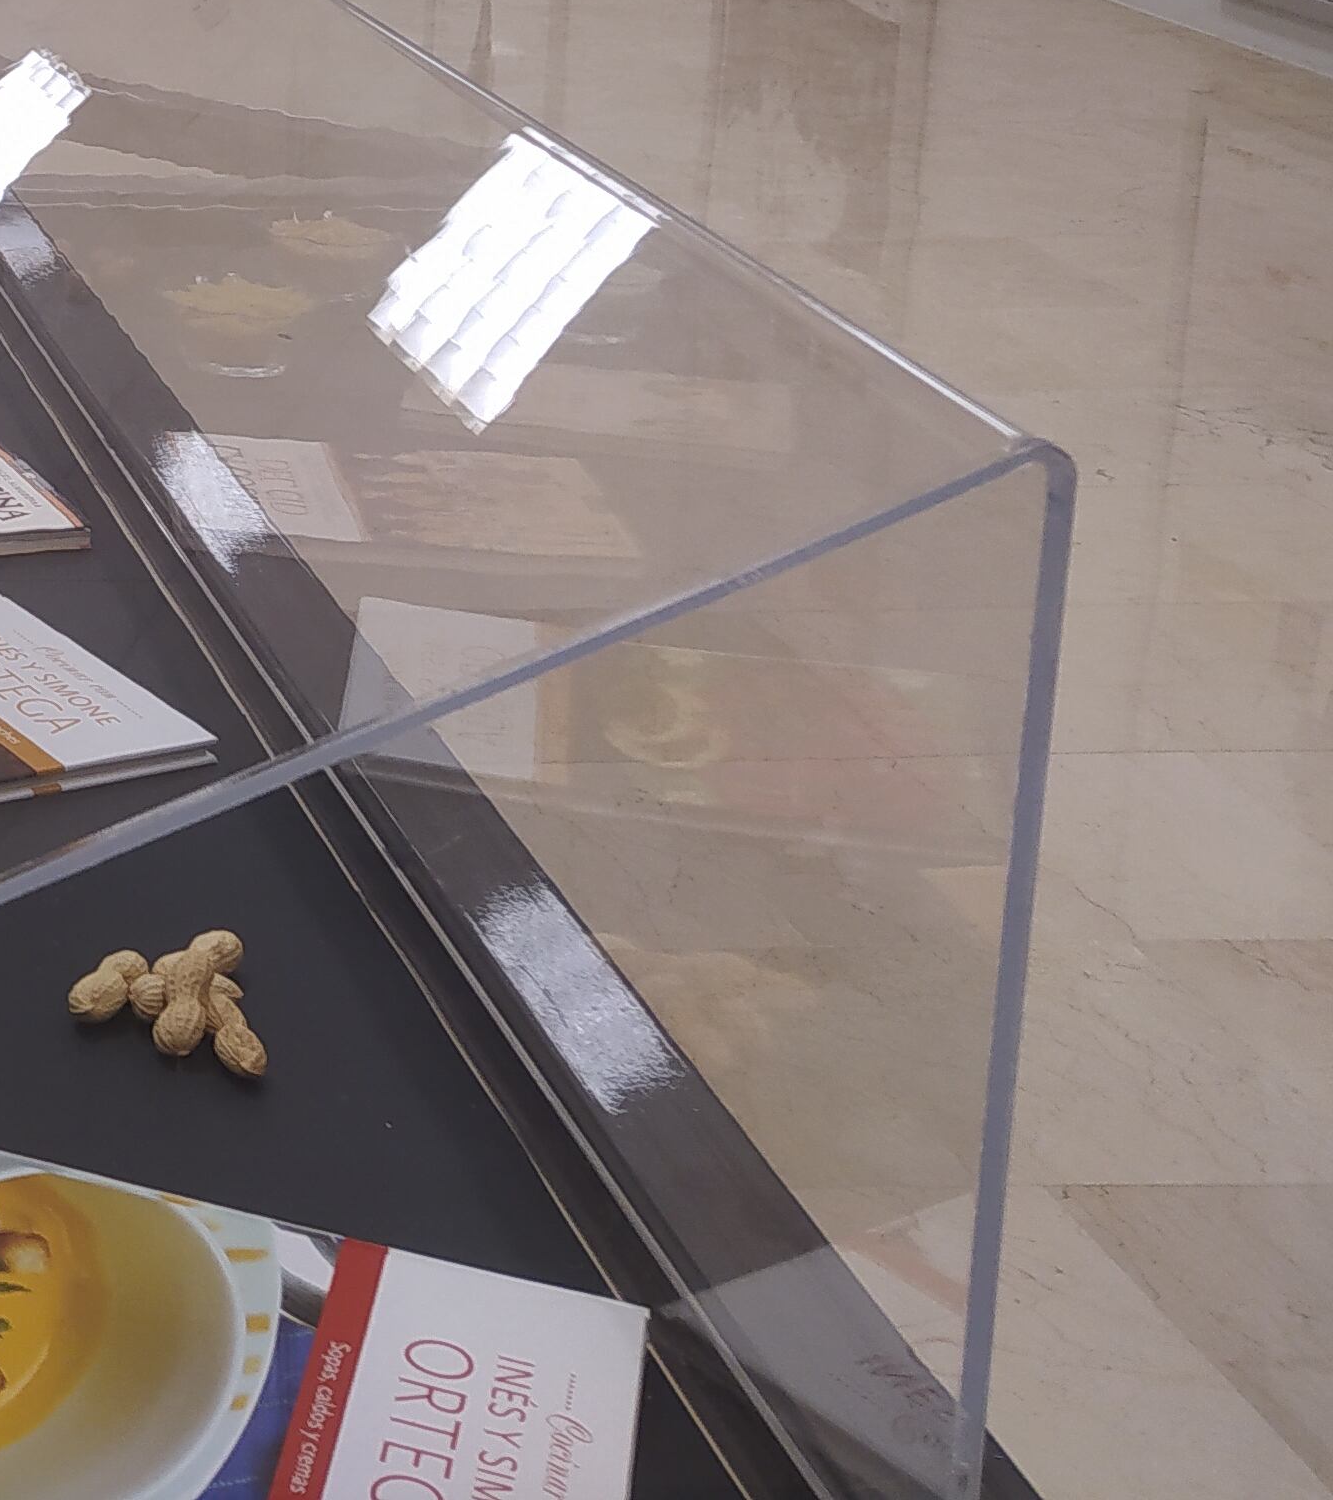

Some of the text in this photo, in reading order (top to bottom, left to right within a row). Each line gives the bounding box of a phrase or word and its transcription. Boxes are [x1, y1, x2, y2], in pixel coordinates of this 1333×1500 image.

[20, 661, 45, 670] Y
[33, 673, 122, 727] SIMONE
[319, 1340, 352, 1383] Sopas,
[307, 1385, 339, 1433] caldos
[487, 1354, 539, 1423] INÉS
[483, 1427, 524, 1449] Y
[289, 1442, 319, 1496] cremas
